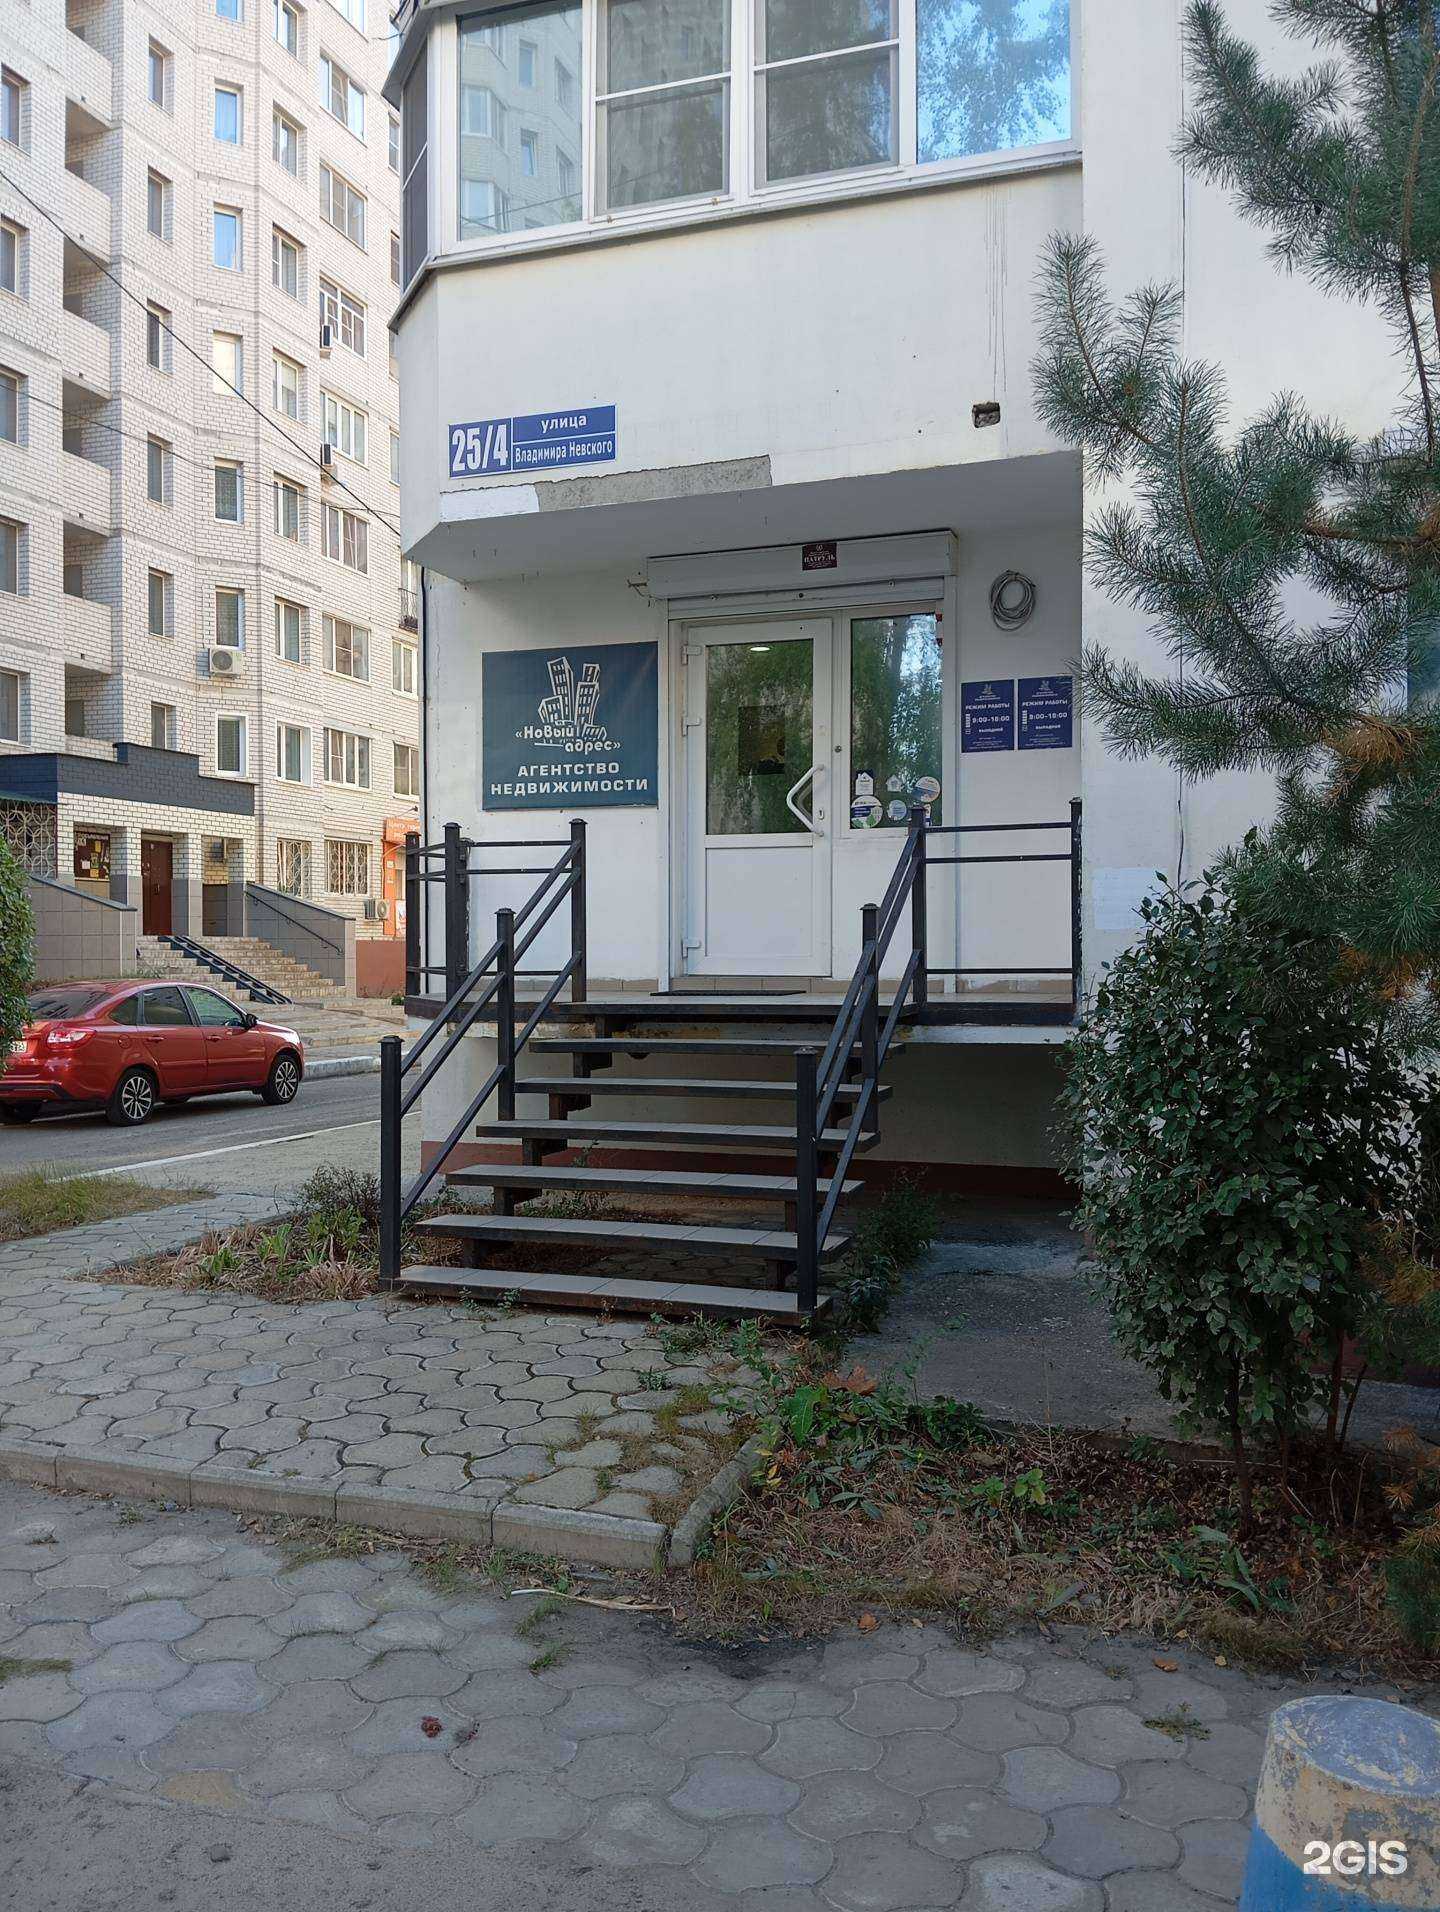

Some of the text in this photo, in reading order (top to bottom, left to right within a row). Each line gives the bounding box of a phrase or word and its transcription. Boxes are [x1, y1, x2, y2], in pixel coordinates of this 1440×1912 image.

[541, 413, 587, 433] улица
[452, 424, 508, 472] 25/4
[515, 439, 613, 463] Владимира Невского
[517, 762, 620, 777] АГЕНТСТВО
[490, 779, 648, 797] НЕДВИЖИМОСТИ
